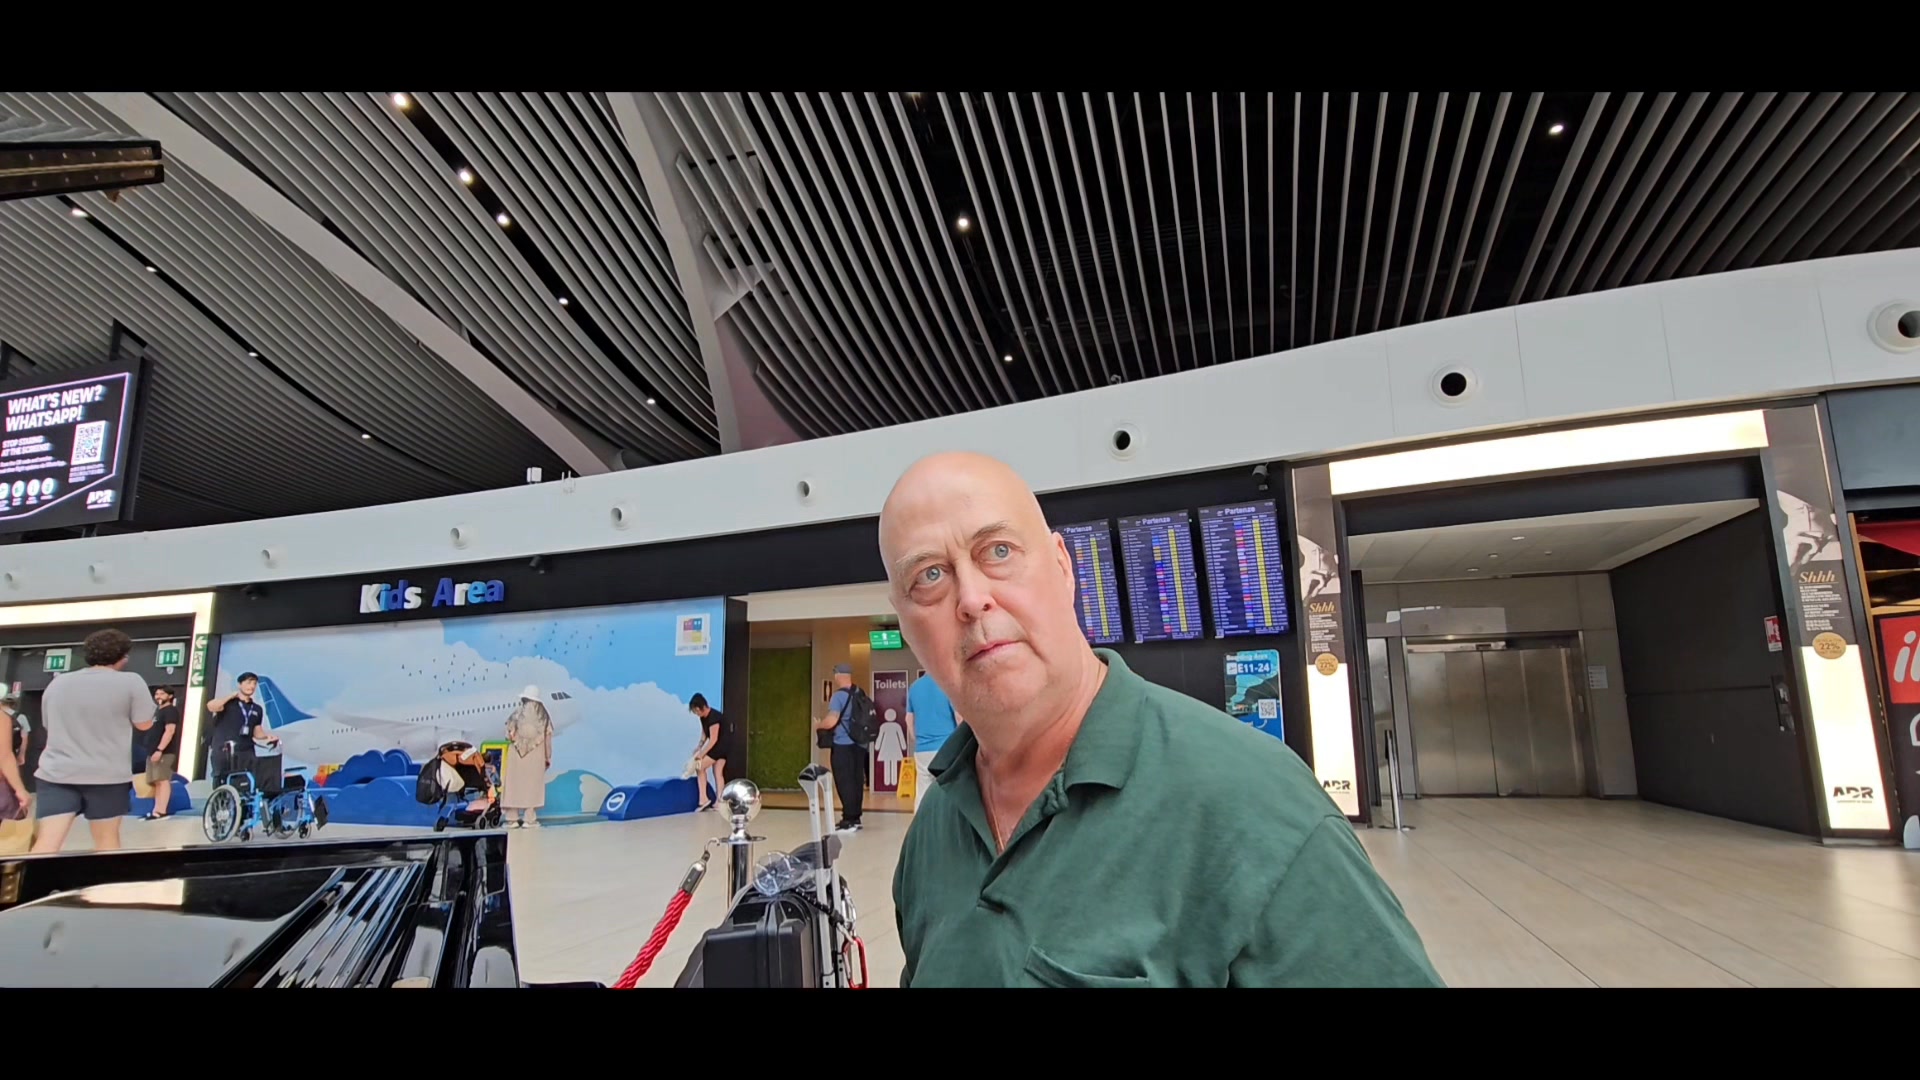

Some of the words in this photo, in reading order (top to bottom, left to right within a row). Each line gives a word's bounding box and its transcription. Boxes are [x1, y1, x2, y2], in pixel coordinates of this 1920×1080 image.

[8, 391, 60, 415] WHAT'S
[61, 384, 104, 406] NEW?
[6, 405, 84, 432] WHATSAPP!
[1224, 506, 1256, 515] Partenze
[1142, 517, 1171, 525] Partenze
[1799, 570, 1836, 583] Shhh
[359, 579, 422, 613] Kids
[432, 577, 505, 607] Area
[1309, 601, 1336, 613] Shhh
[1819, 642, 1841, 650] 22%
[1237, 662, 1271, 674] E11-24
[875, 679, 906, 688] Toilets
[1322, 780, 1351, 790] ADR
[1833, 786, 1874, 799] ADR
